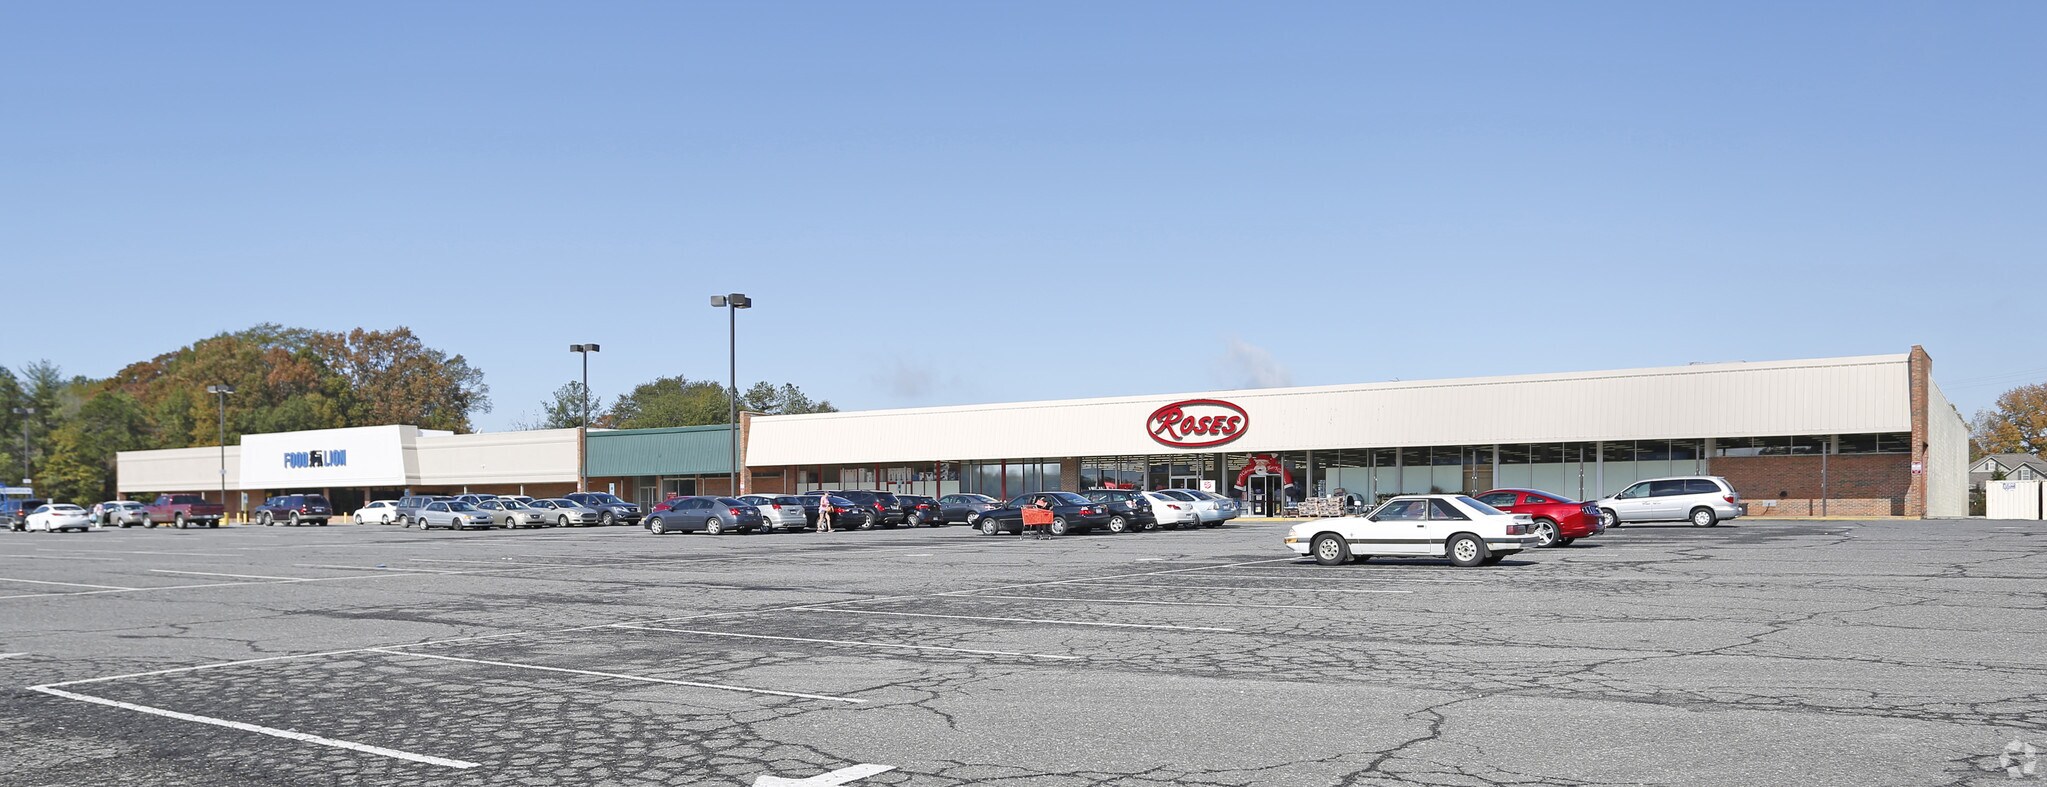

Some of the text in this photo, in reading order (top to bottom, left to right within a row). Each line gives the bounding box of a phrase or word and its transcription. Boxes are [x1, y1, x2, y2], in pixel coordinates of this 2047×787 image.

[1155, 407, 1241, 440] ROSES
[284, 449, 346, 468] FOOD LION
